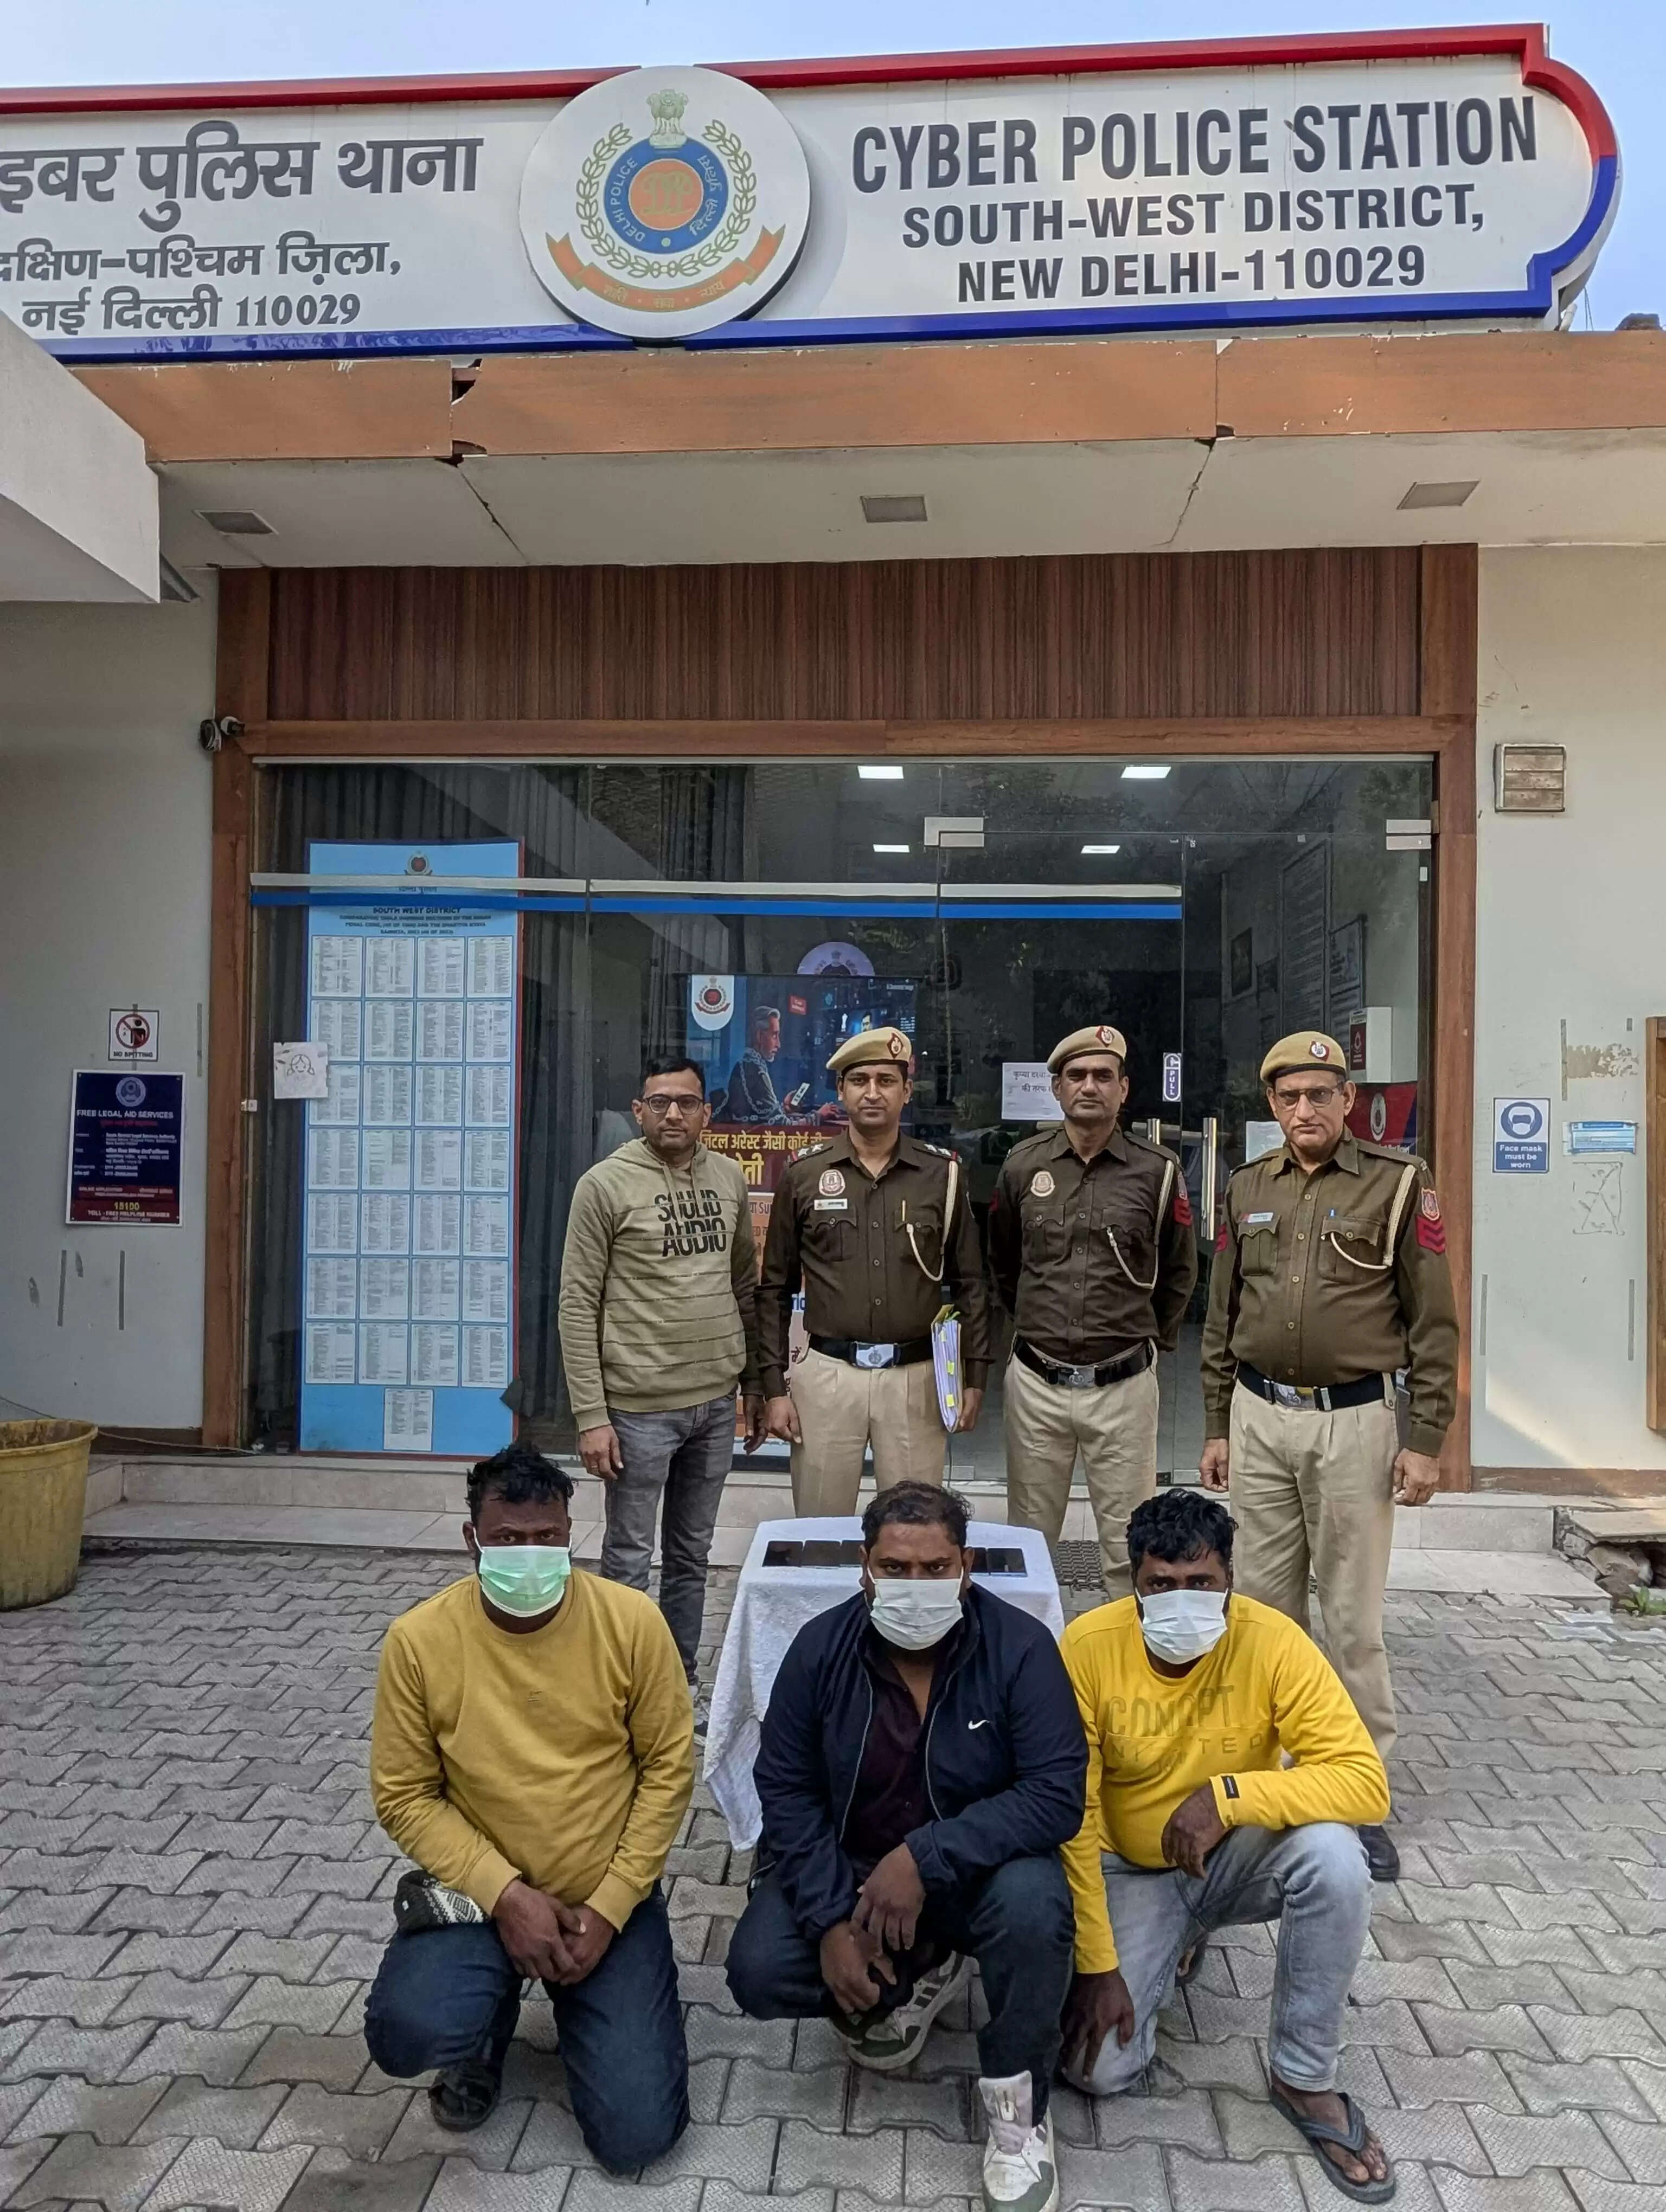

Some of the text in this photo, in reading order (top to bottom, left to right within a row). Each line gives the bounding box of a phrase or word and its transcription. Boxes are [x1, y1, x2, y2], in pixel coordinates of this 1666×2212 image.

[854, 97, 1536, 192] CYBER POLICE STATION
[136, 120, 321, 233] पुलिस
[338, 138, 484, 193] थाना
[610, 158, 646, 242] DELHI POLICE
[904, 184, 1482, 247] SOUTH-WEST DISTRICT,
[276, 230, 400, 285] ज़िला,
[959, 246, 1424, 302] NEW DELHI-110029
[23, 284, 360, 335] नई दिल्ली 110029
[98, 1110, 123, 1118] LEGAL
[124, 1110, 137, 1118] AID
[138, 1110, 174, 1118] SERVICES
[731, 1129, 761, 1149] अरेस्ट
[761, 1129, 786, 1150] जैसी
[662, 1218, 727, 1257] AUDIO
